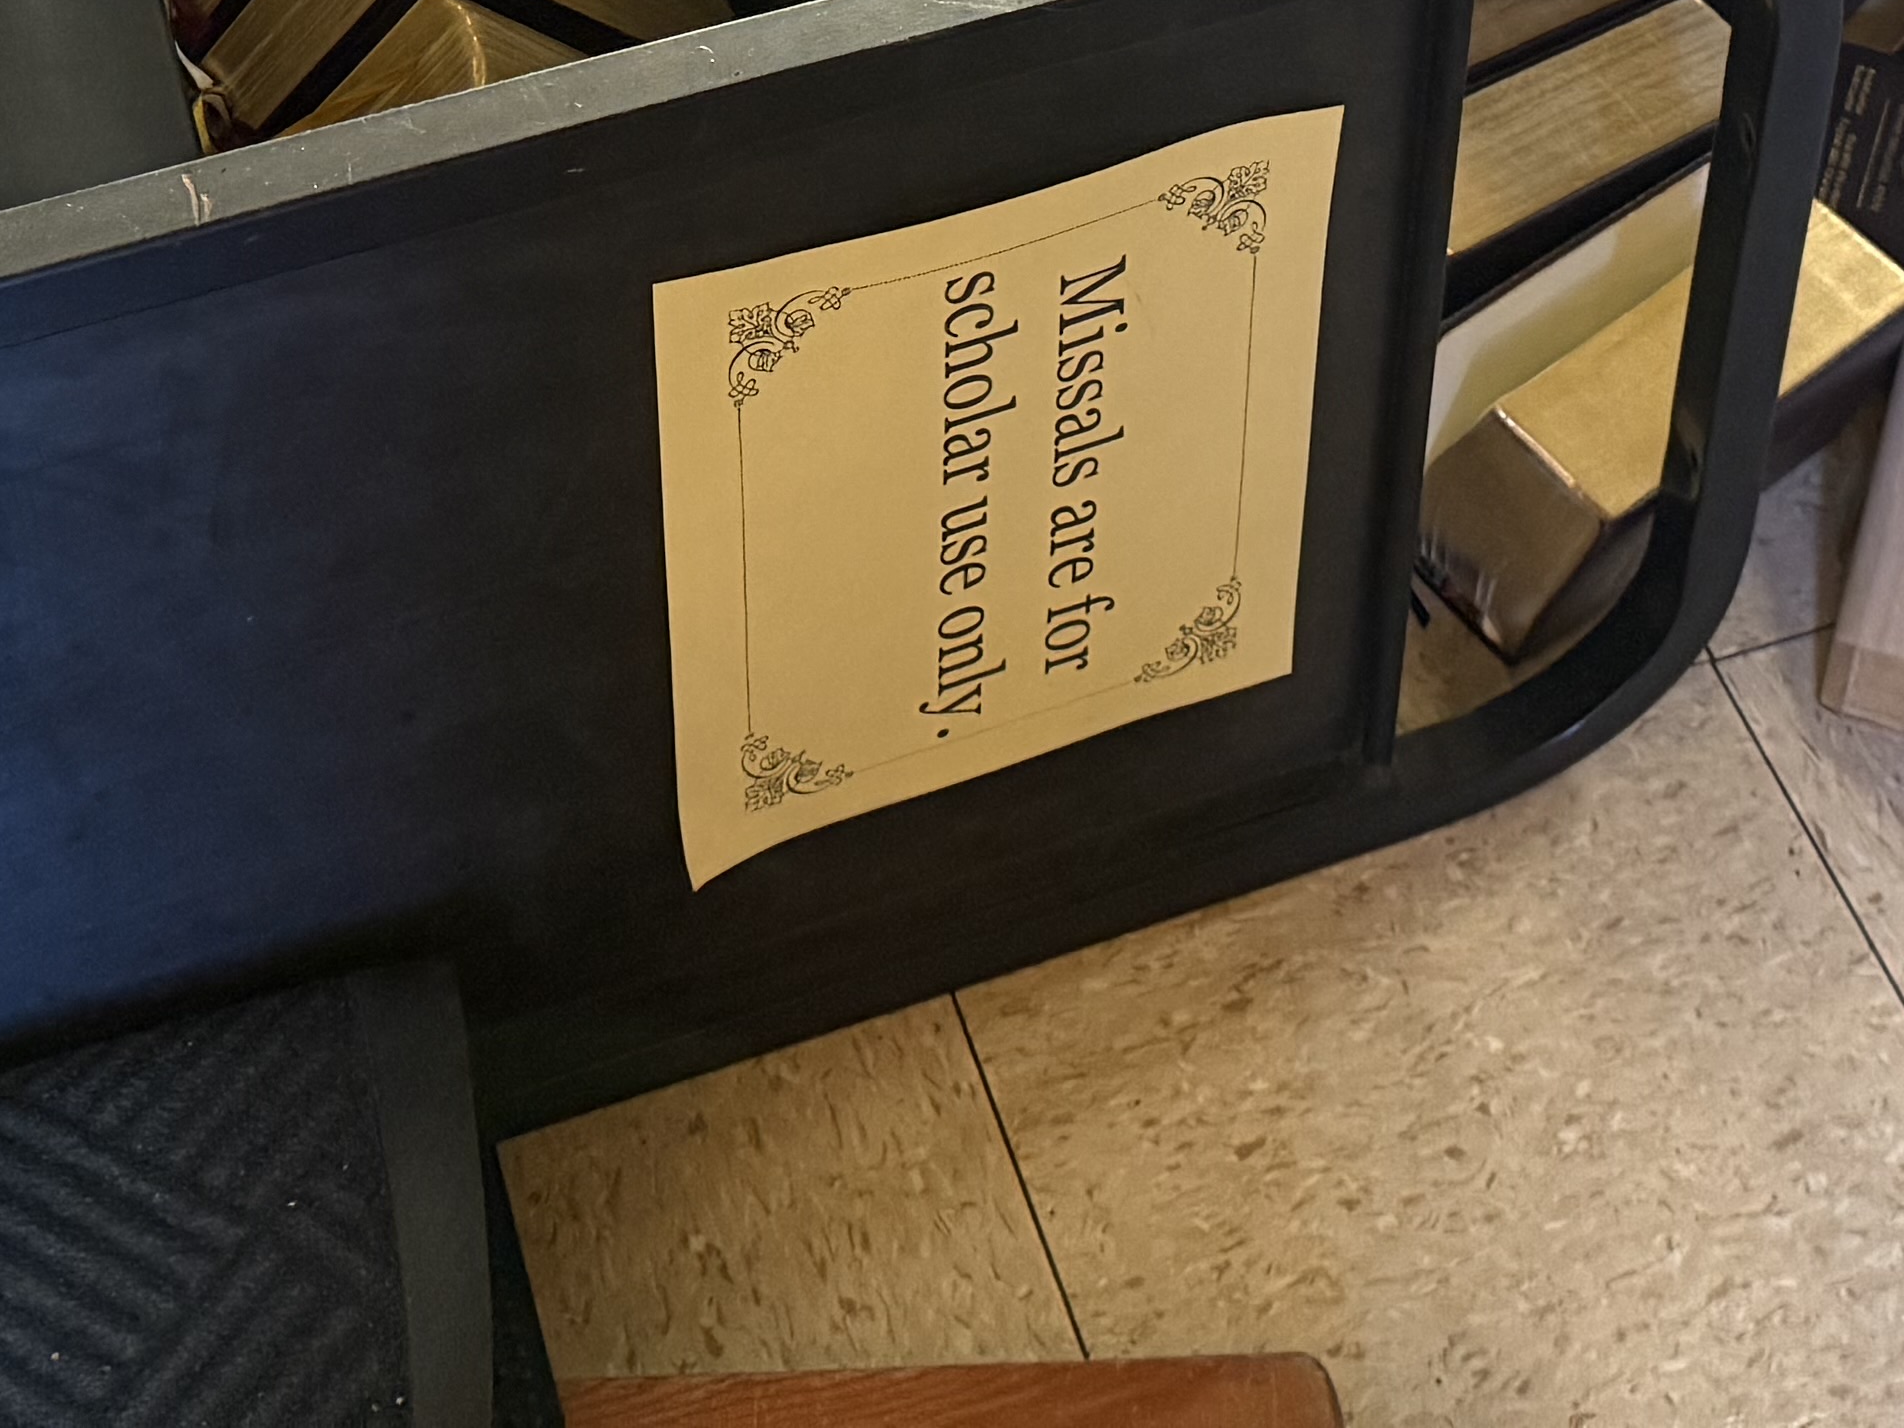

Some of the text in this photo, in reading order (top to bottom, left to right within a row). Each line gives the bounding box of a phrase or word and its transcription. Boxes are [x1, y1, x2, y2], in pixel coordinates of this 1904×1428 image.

[918, 270, 1019, 740] scholar use only.
[1044, 253, 1128, 676] Missals are for
